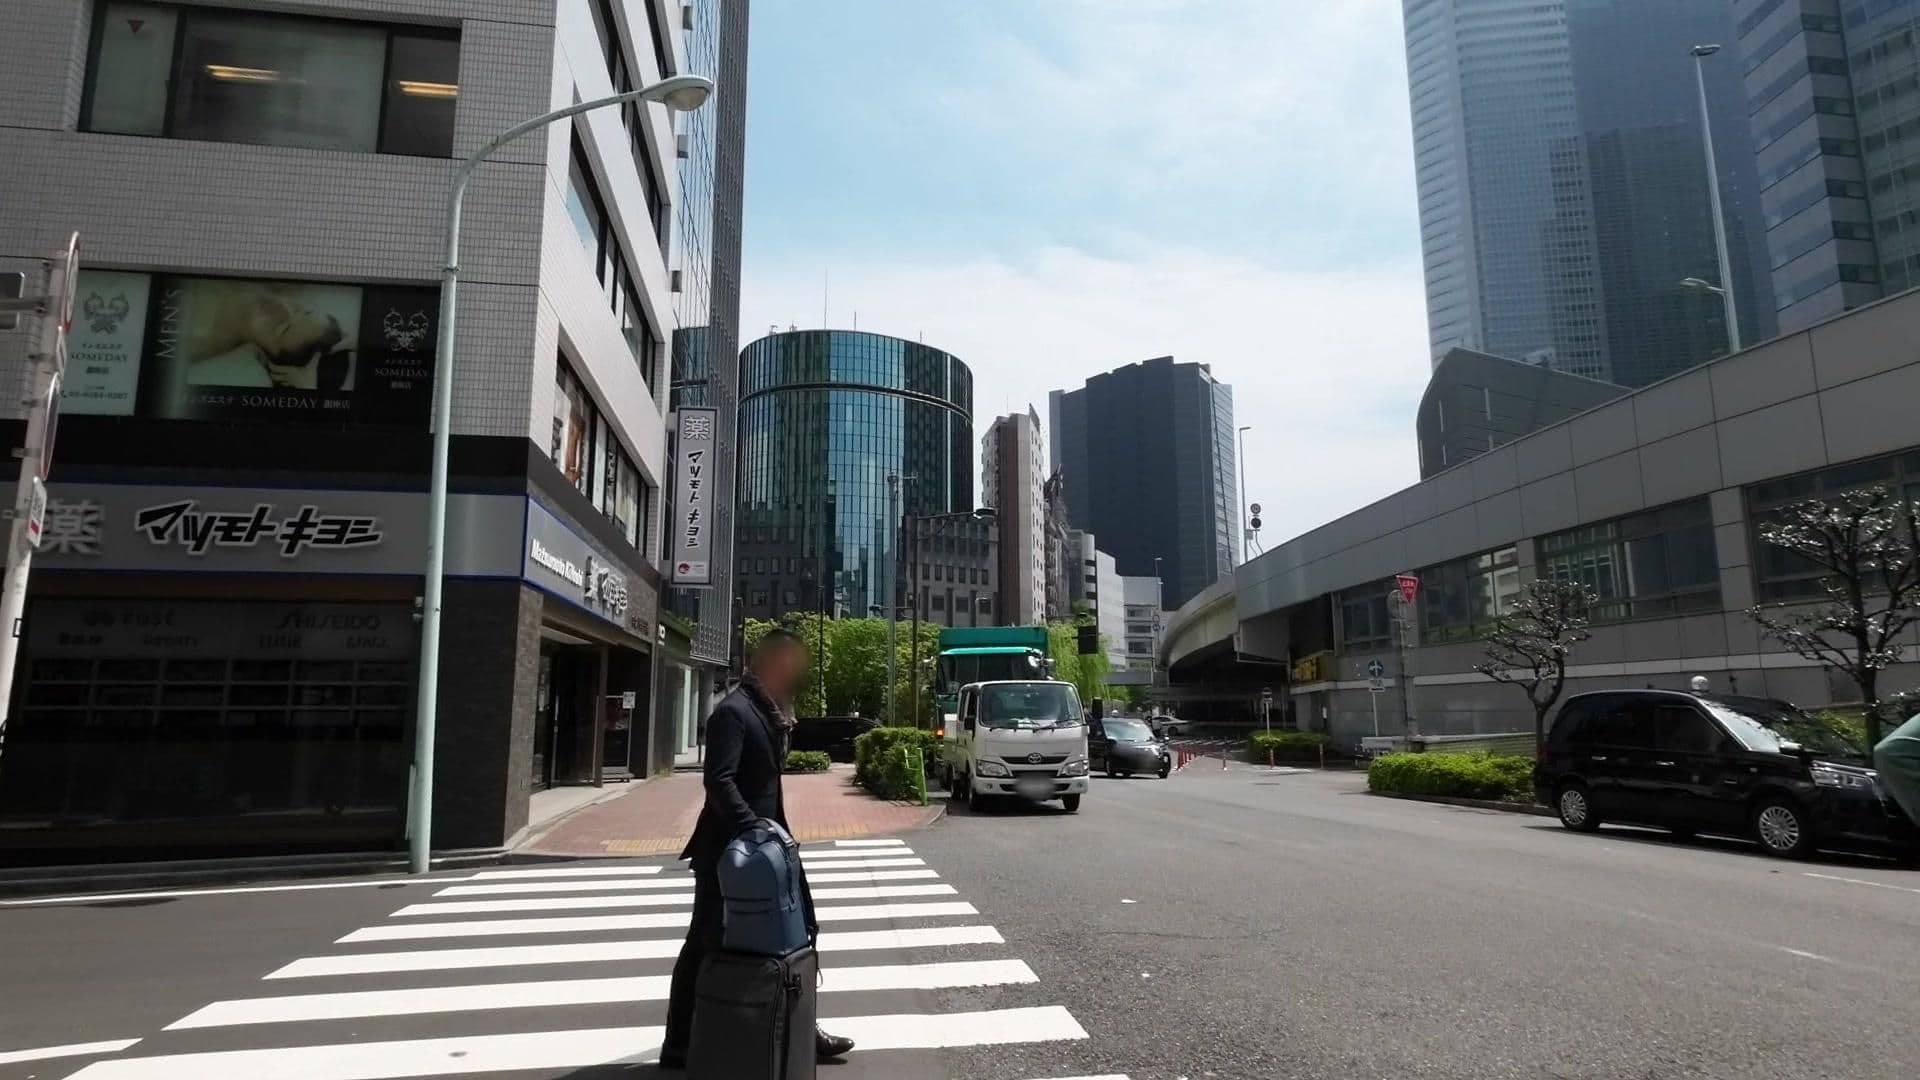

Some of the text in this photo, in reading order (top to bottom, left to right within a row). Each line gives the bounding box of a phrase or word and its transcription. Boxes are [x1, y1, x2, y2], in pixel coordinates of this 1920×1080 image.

[71, 352, 128, 363] SOMEDAY
[375, 367, 427, 377] SOMEDAY
[241, 395, 319, 409] SOMEDAY
[684, 415, 711, 441] 薬
[686, 449, 705, 549] マツモトキヨシ
[37, 499, 103, 554] 薬
[136, 501, 382, 557] マツモトキヨシ
[273, 612, 381, 630] SHISEIDO
